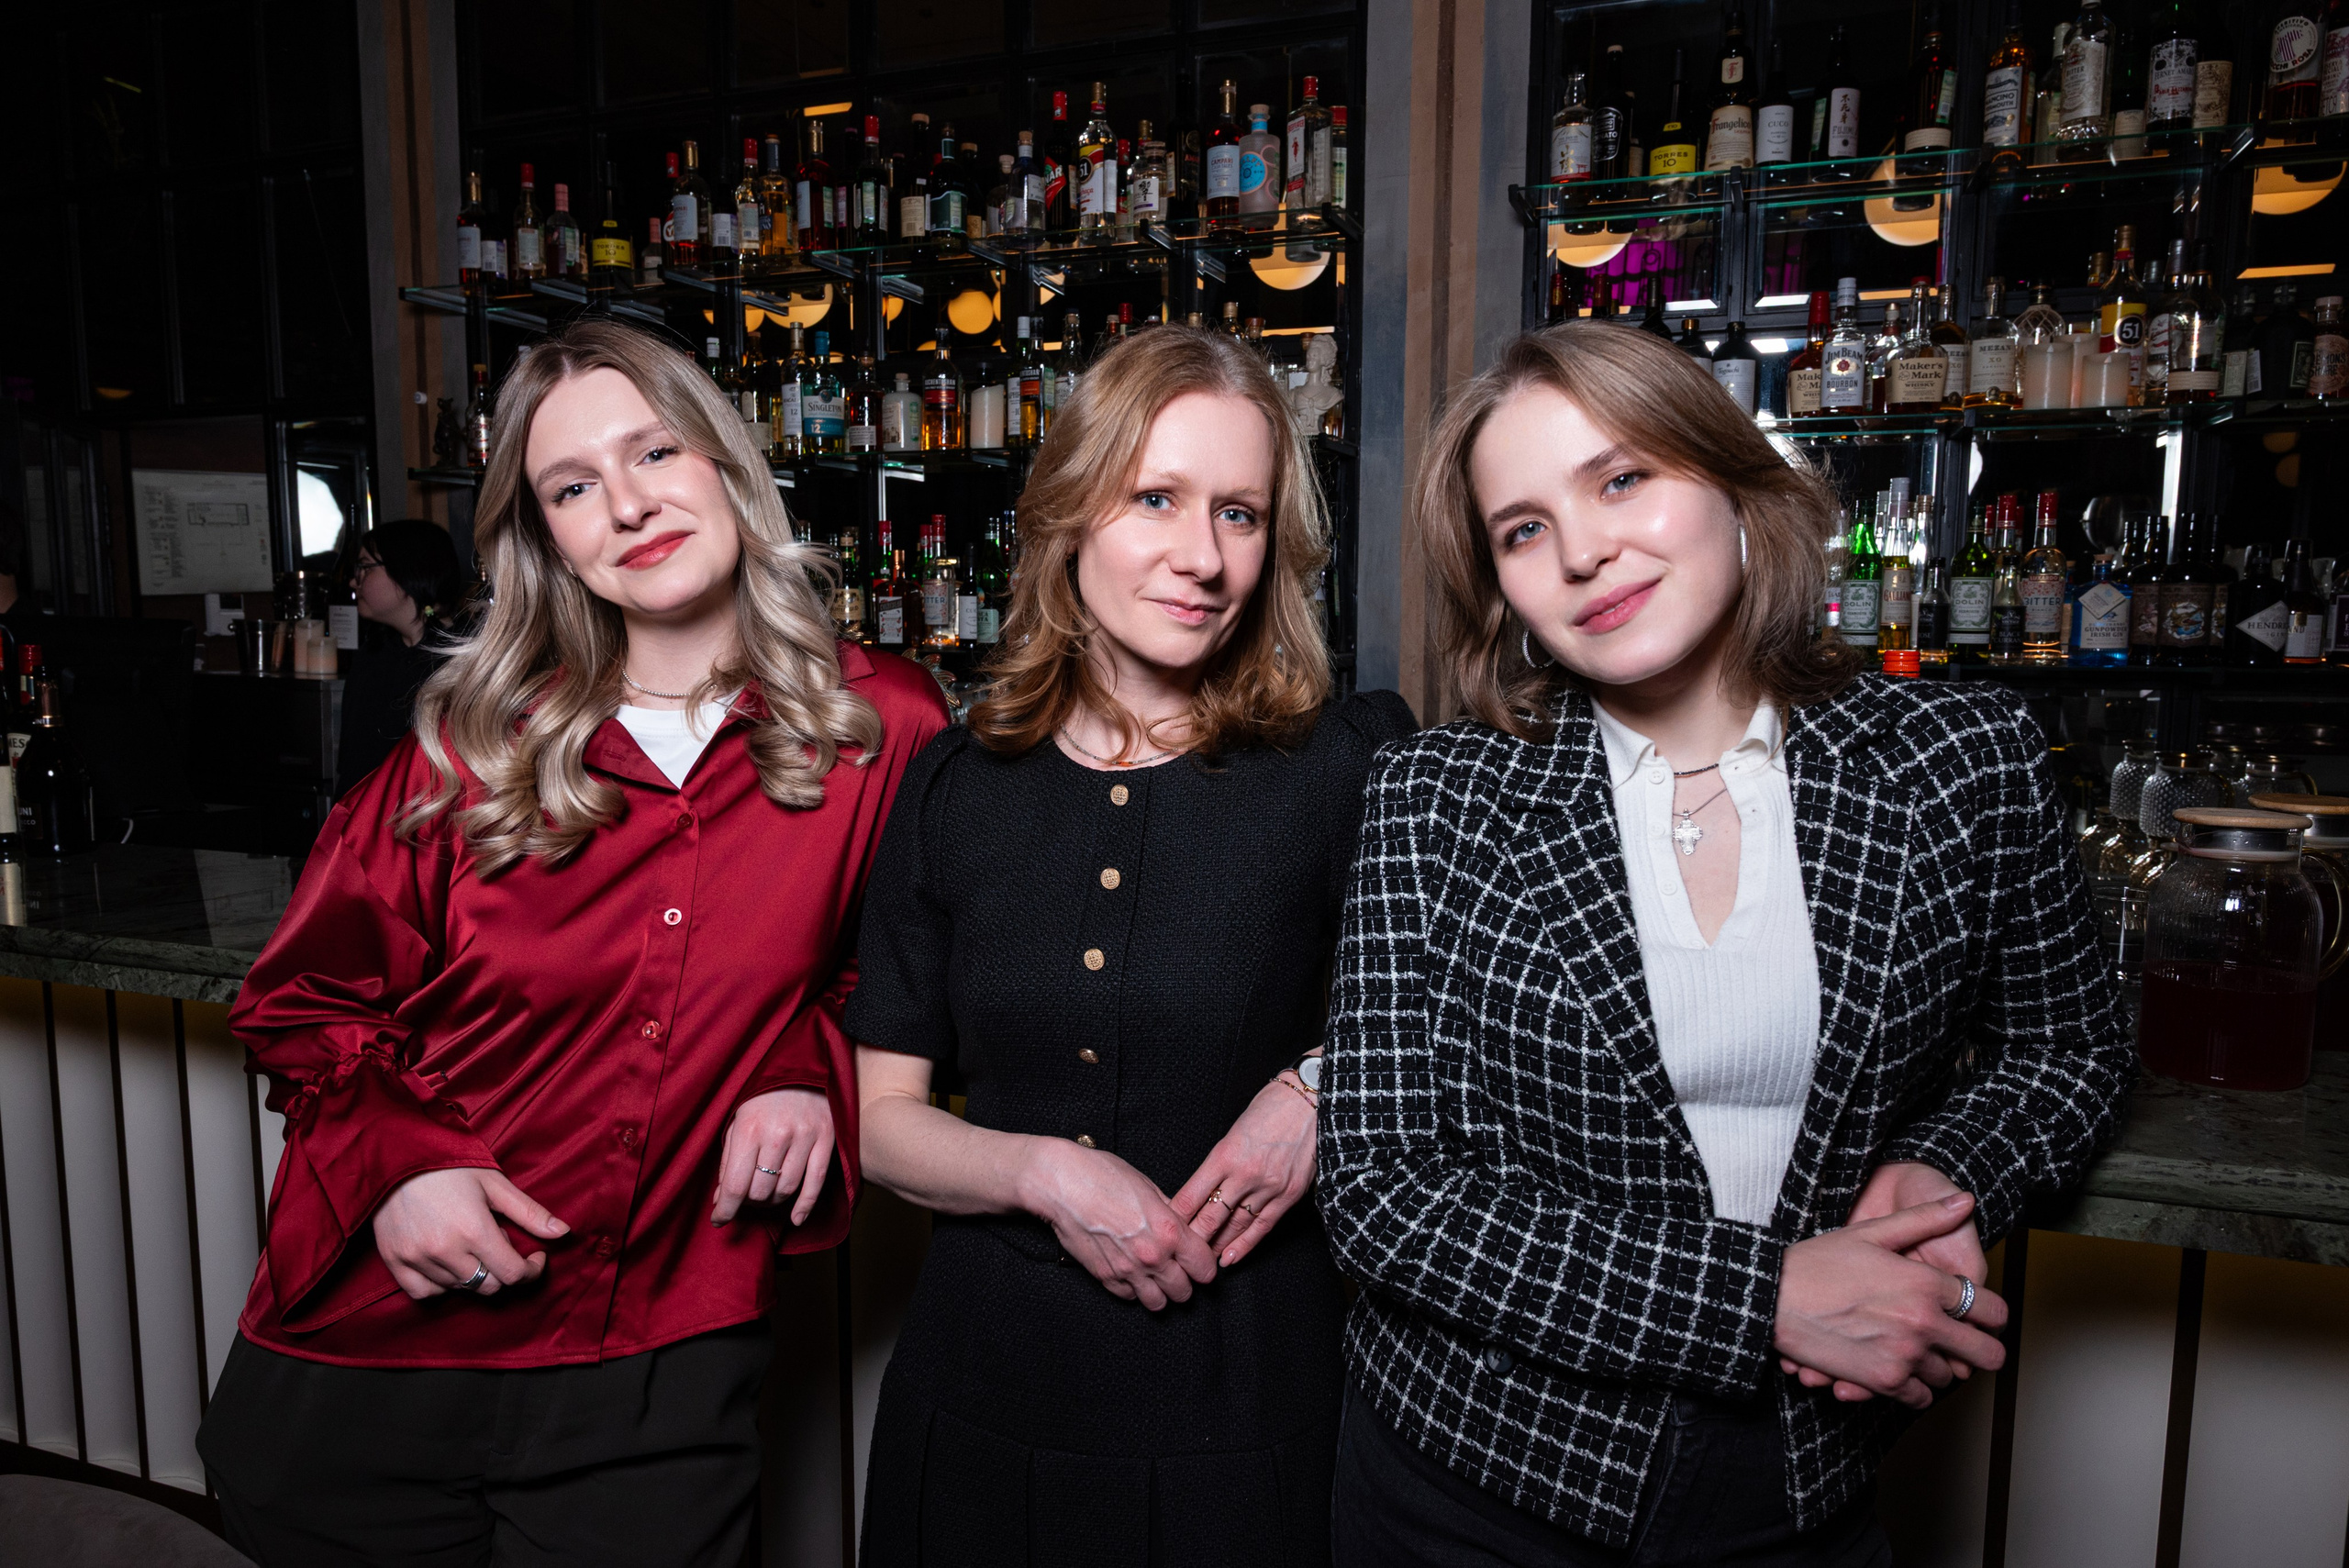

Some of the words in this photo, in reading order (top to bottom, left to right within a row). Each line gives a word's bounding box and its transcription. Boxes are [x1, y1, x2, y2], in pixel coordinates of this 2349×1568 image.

[2292, 49, 2314, 67] ROSA
[1710, 117, 1753, 134] Frangelico
[1653, 151, 1688, 161] TORRES
[1210, 158, 1234, 166] CAMPARI
[1663, 158, 1676, 168] 10
[2121, 322, 2141, 339] 51
[1978, 344, 2012, 352] MEZAN
[1824, 350, 1841, 365] JIM
[1841, 347, 1863, 363] BEAM
[1898, 361, 1943, 371] Maker's
[1911, 371, 1943, 379] Mark
[1826, 379, 1859, 389] BOURBON
[807, 402, 842, 413] SINGLETON
[810, 423, 821, 434] 12
